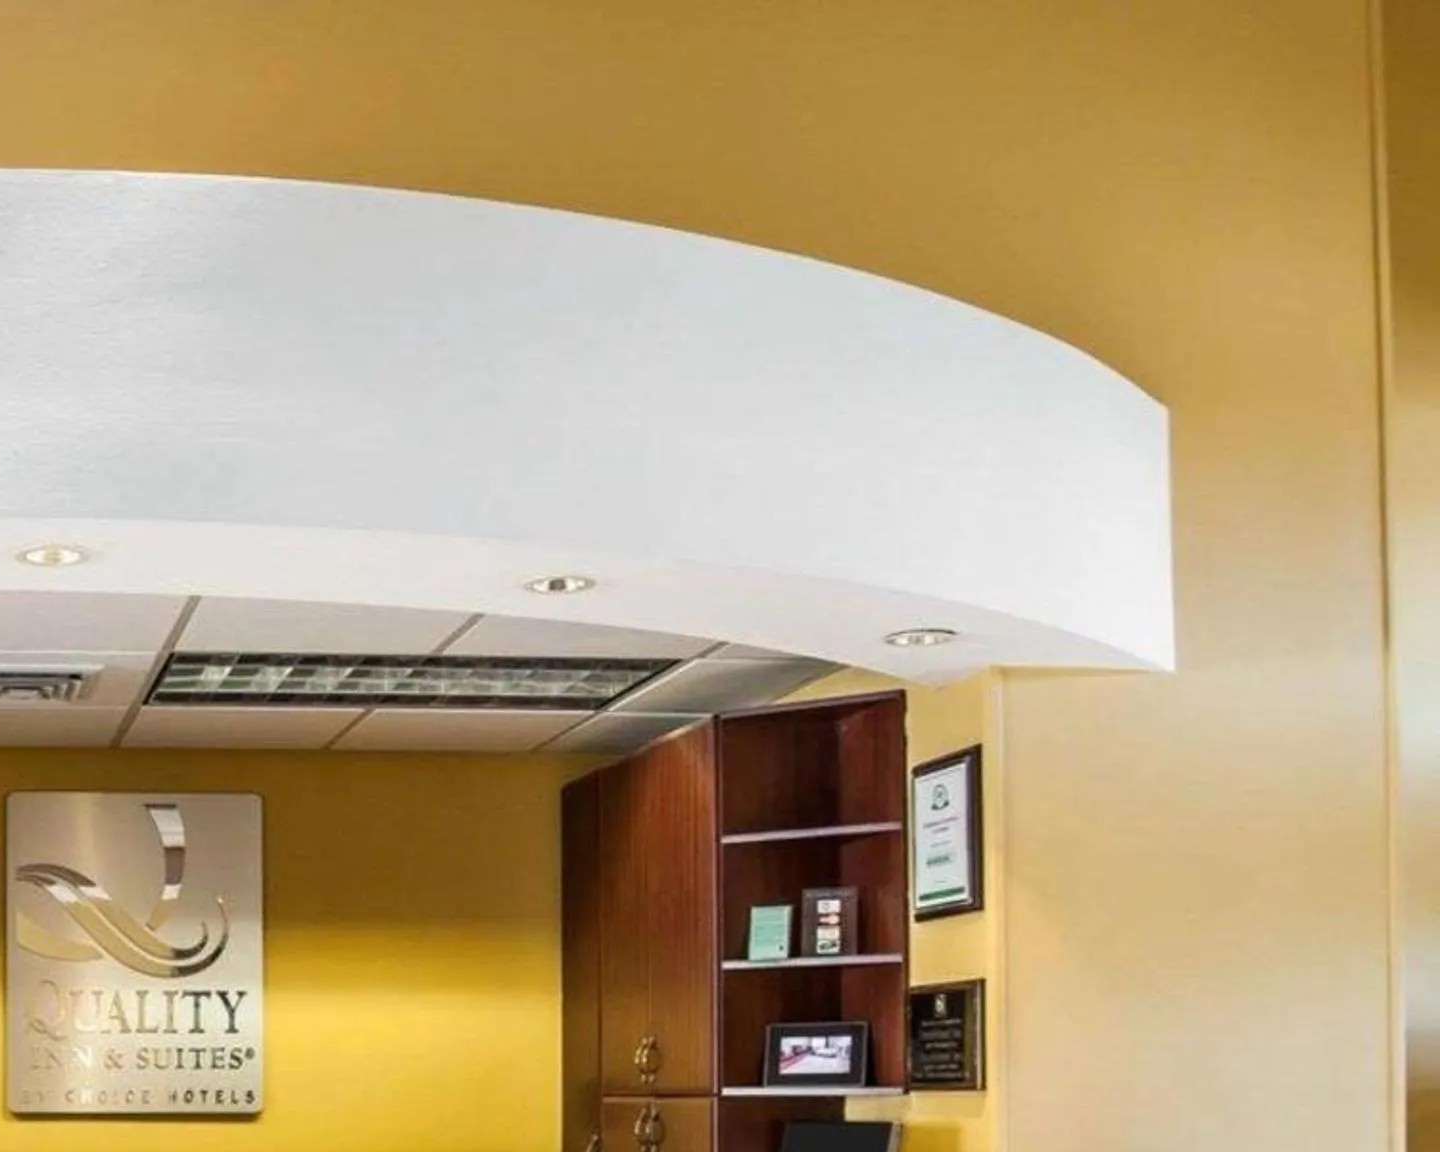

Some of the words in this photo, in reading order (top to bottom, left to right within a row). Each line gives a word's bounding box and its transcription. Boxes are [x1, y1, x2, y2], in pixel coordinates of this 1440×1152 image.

[25, 979, 248, 1042] QUALITY
[31, 1048, 94, 1071] INN
[103, 1048, 124, 1070] &
[64, 1089, 152, 1106] CHOICE
[168, 1089, 256, 1106] HOTELS
